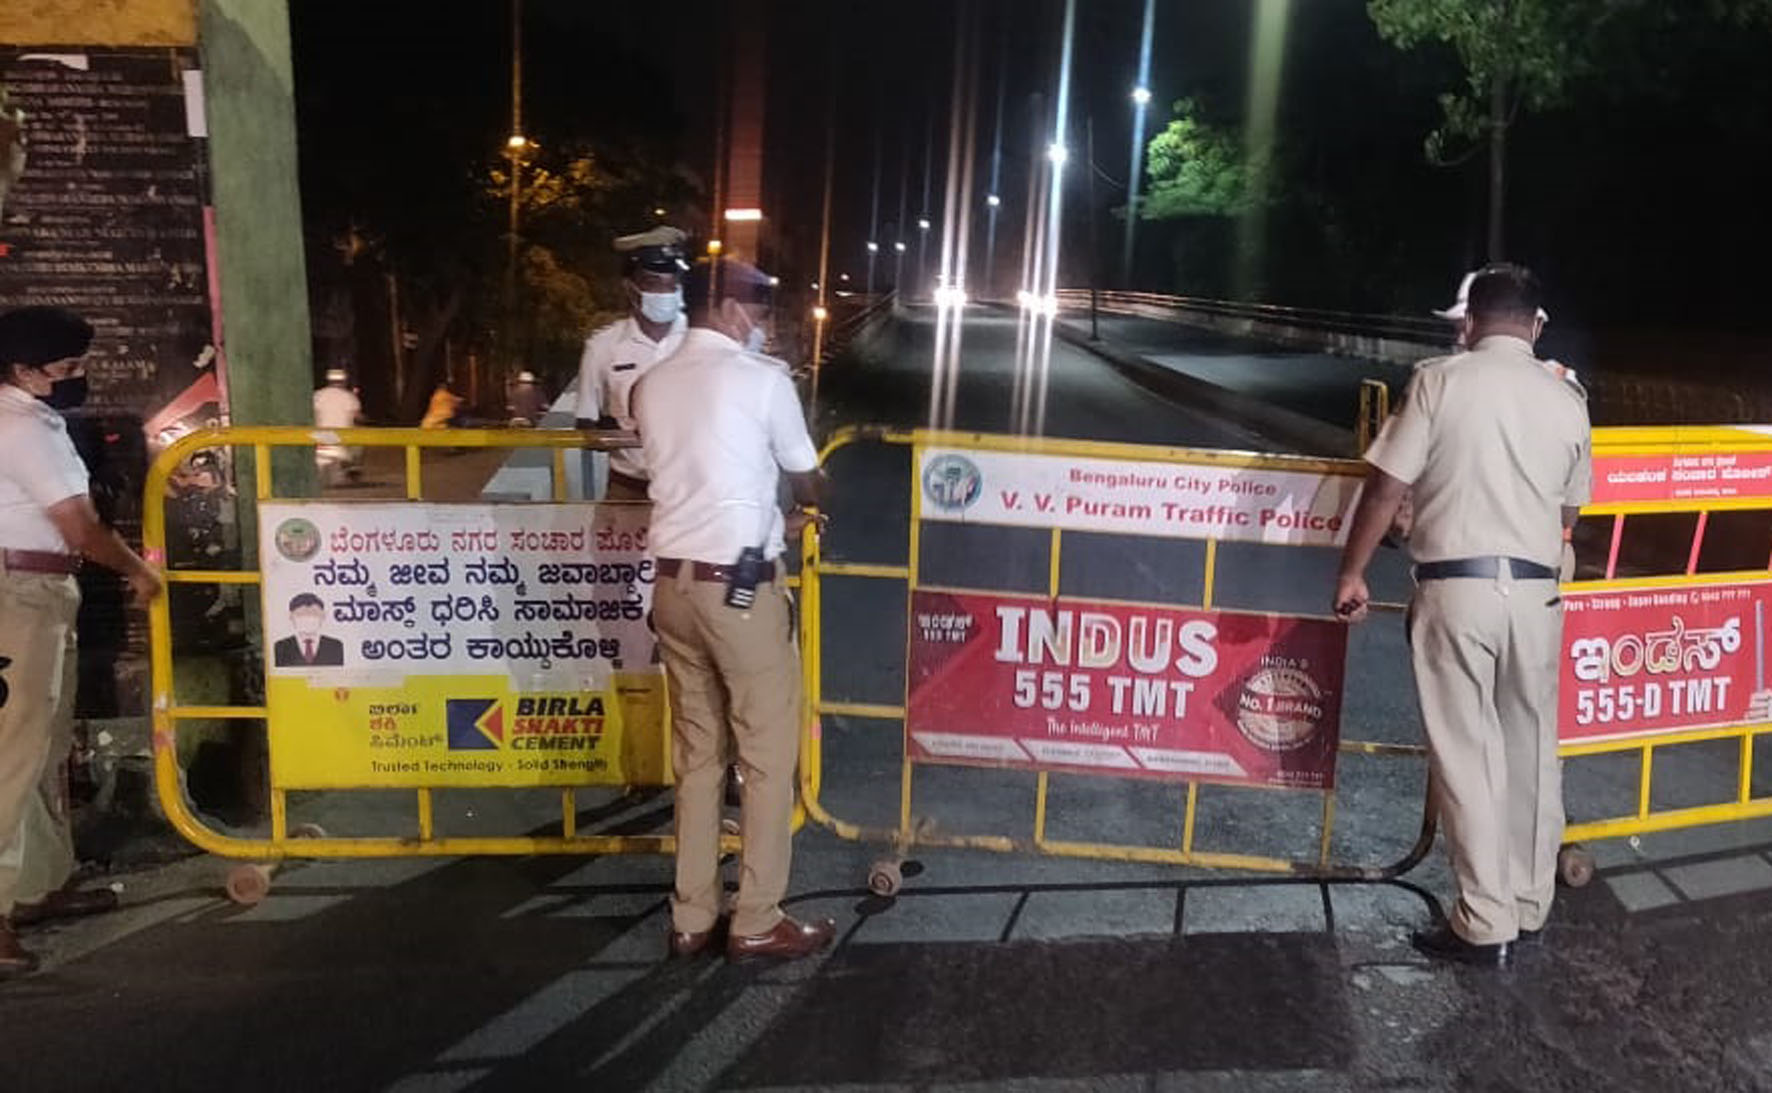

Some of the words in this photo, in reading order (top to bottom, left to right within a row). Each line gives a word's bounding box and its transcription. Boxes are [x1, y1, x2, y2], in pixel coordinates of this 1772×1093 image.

[1069, 468, 1167, 489] Bengaluru
[1174, 476, 1211, 494] City
[1218, 479, 1277, 496] Police
[1001, 490, 1022, 510] V.
[1034, 493, 1055, 512] V.
[1066, 496, 1151, 519] Puram
[1162, 503, 1249, 526] Traffic
[1259, 508, 1343, 532] Police
[330, 526, 440, 552] ಬೆಂಗಳೂರು
[451, 527, 497, 552] ನಗರ
[510, 527, 585, 551] ಸಂಚಾರ
[313, 557, 378, 597] ನಮ್ಮ
[389, 557, 450, 585] ಜೀವ
[465, 556, 527, 596] ನಮ್ಮ
[332, 595, 416, 628] ಮಾಸ್ಕ್
[430, 594, 499, 626] ಧರಿಸಿ
[513, 592, 644, 621] ಸಾಮಾಜಿಕ
[361, 632, 452, 661] ಅಂತರ
[995, 606, 1218, 677] INDUS
[1571, 616, 1741, 684] ಇಂಡಸ್
[516, 698, 605, 716] BIRLA
[1014, 670, 1091, 711] 555
[1107, 676, 1194, 718] TMT
[1576, 683, 1662, 724] 555-D
[1669, 677, 1731, 714] TMT
[512, 718, 604, 734] SHAKTI
[1047, 717, 1067, 736] The
[511, 736, 601, 750] CEMENT
[371, 761, 419, 774] Trusted
[425, 760, 502, 773] Technology
